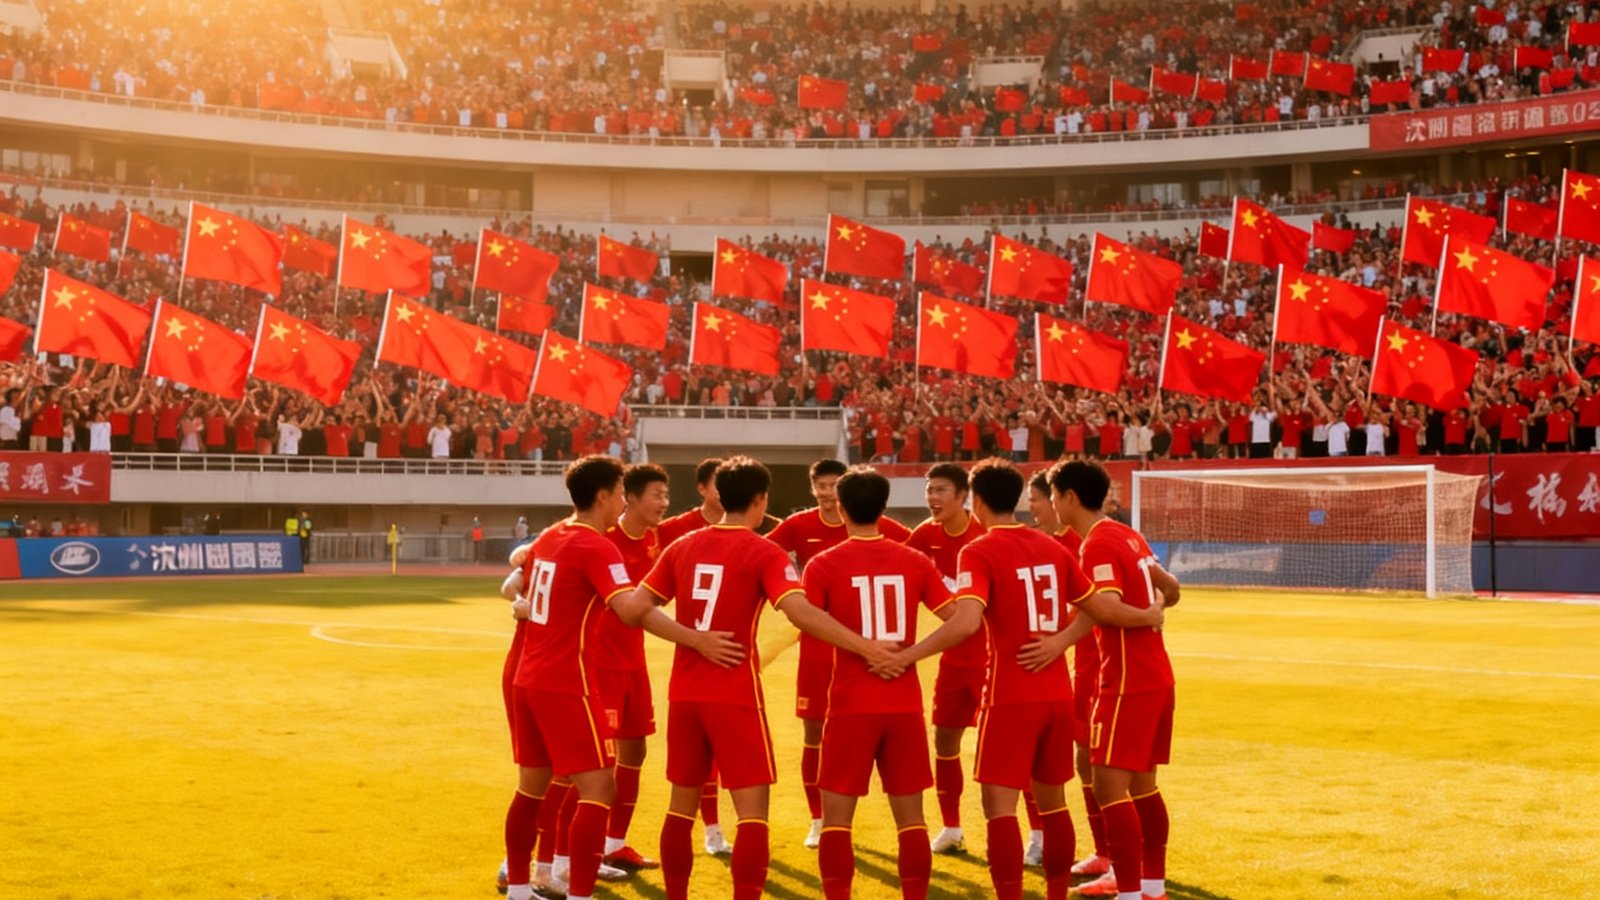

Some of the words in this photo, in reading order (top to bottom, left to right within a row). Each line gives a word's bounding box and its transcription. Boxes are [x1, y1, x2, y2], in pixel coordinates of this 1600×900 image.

[691, 563, 724, 631] 9
[851, 574, 906, 642] 10
[1016, 564, 1059, 632] 13
